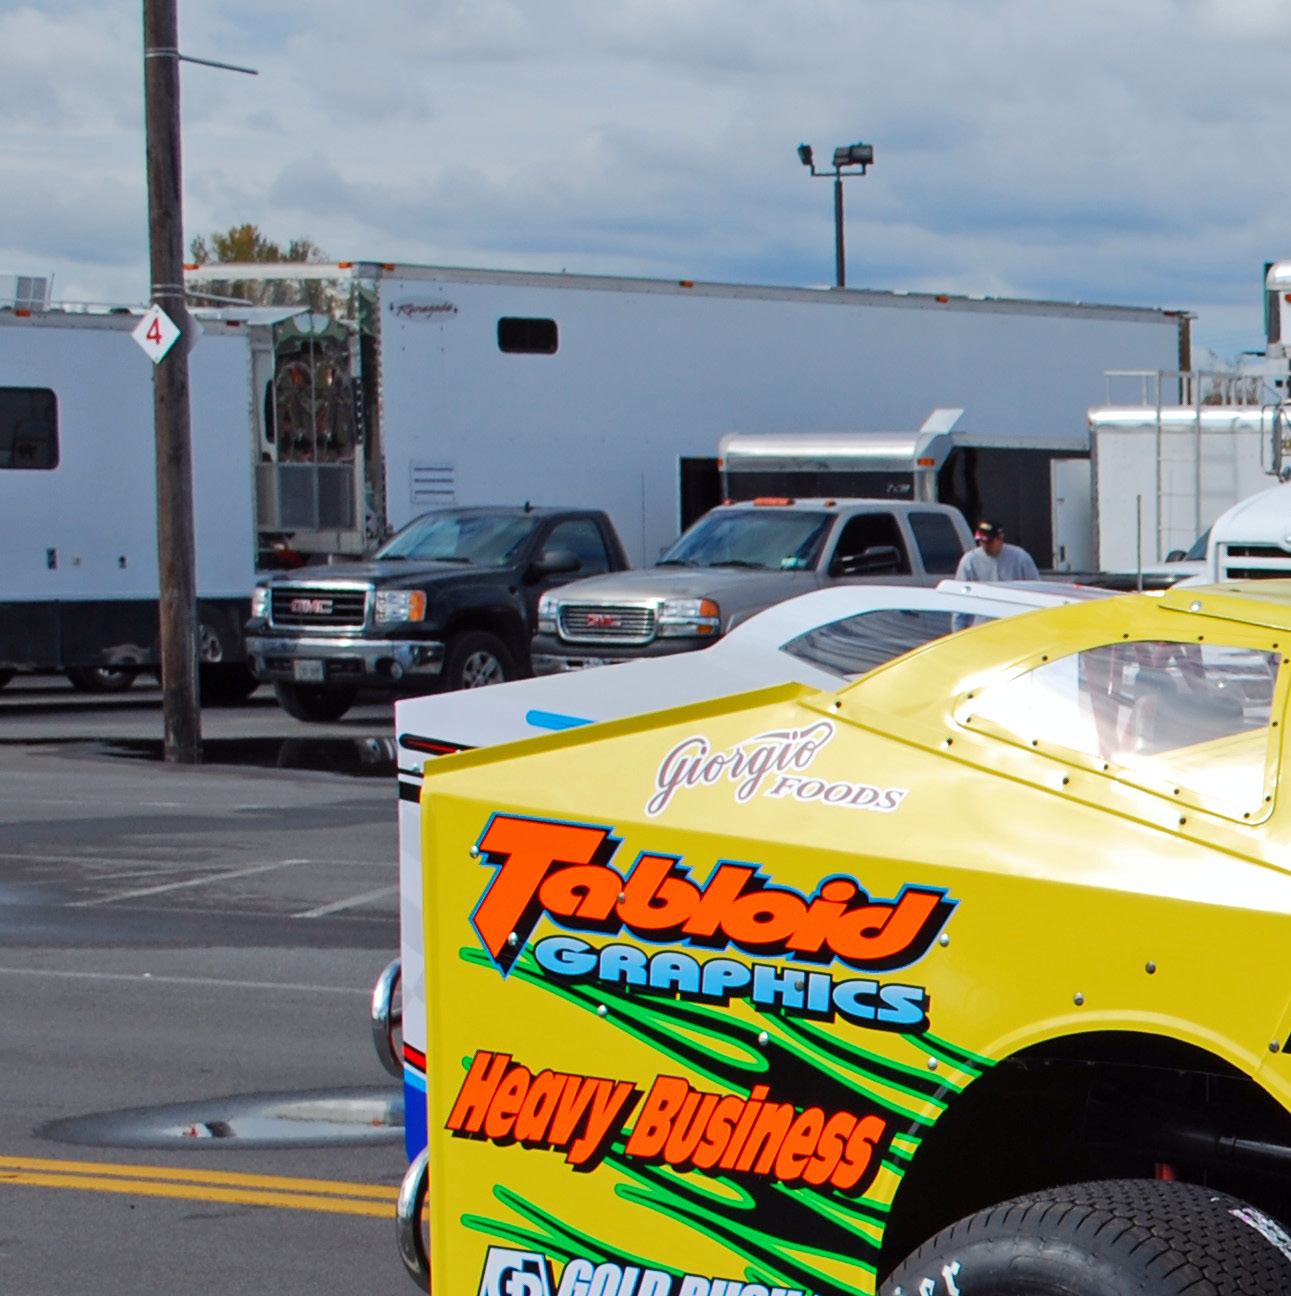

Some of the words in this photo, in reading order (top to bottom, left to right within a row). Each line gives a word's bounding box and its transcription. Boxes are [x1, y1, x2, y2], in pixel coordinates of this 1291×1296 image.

[146, 316, 162, 344] 4
[290, 599, 333, 614] GMC
[646, 719, 836, 816] Giorgio
[765, 775, 908, 812] FOODS
[470, 811, 960, 980] Tabloid
[531, 934, 931, 1034] GRAPHICS
[445, 1050, 637, 1170] Heavy
[624, 1074, 888, 1195] Business
